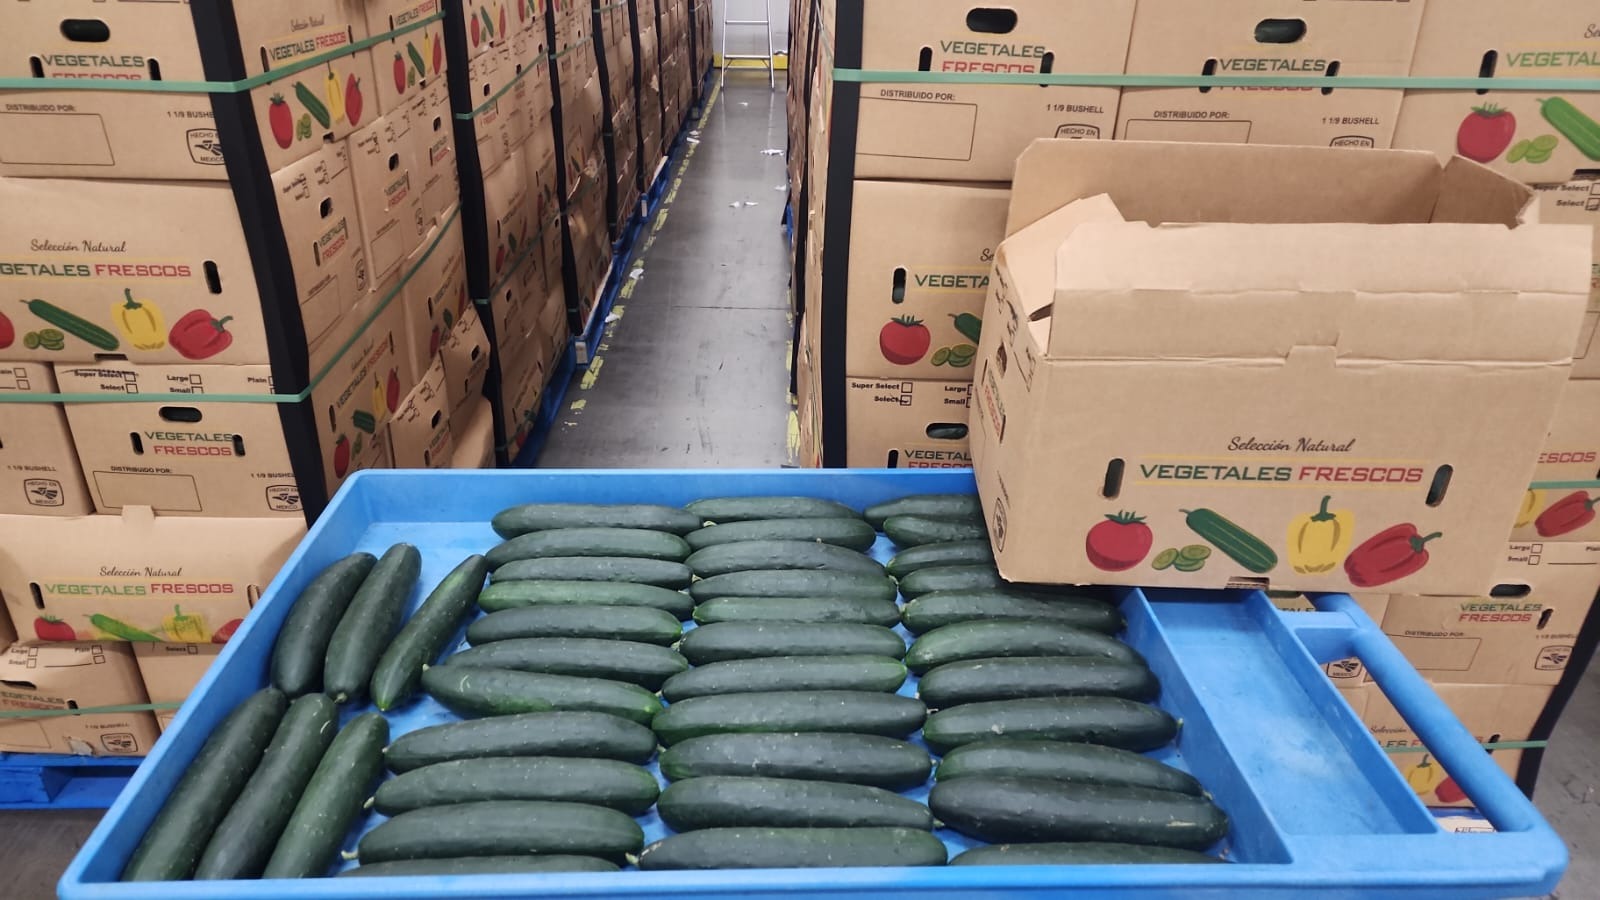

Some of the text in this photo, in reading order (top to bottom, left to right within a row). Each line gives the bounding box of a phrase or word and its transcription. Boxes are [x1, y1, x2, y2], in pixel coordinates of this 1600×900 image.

[269, 31, 347, 61] VEGETALES FRESCOS
[940, 40, 1046, 58] VEGETALES
[41, 54, 145, 67] VEGETALES
[1219, 58, 1327, 72] VEGETALES
[1506, 52, 1600, 67] VEGETAL
[880, 89, 956, 101] DISTRIBUIDO POR:
[186, 111, 214, 119] BUSHE
[1066, 104, 1104, 114] BUSHELL
[1153, 110, 1231, 119] DISTRIBUIDO POR:
[1341, 117, 1380, 125] BUSHELL
[1556, 199, 1585, 207] Select
[31, 239, 126, 253] Selección Natural
[0, 262, 191, 277] GETALES FRESCOS
[914, 274, 989, 289] VEGETA
[167, 375, 189, 383] Large
[145, 431, 233, 442] VEGETALES
[153, 445, 233, 456] FRESCOS
[1227, 436, 1356, 453] Selección Natural
[904, 449, 972, 461] VEGETAL
[1537, 452, 1597, 464] ESCOS
[1139, 464, 1424, 482] VEGETALES FRESCOS
[99, 566, 183, 578] Selección Natural
[44, 583, 234, 596] VEGETALES FRESCOS
[1460, 603, 1543, 612] VEGETALES
[1458, 613, 1532, 622] FRESCOS
